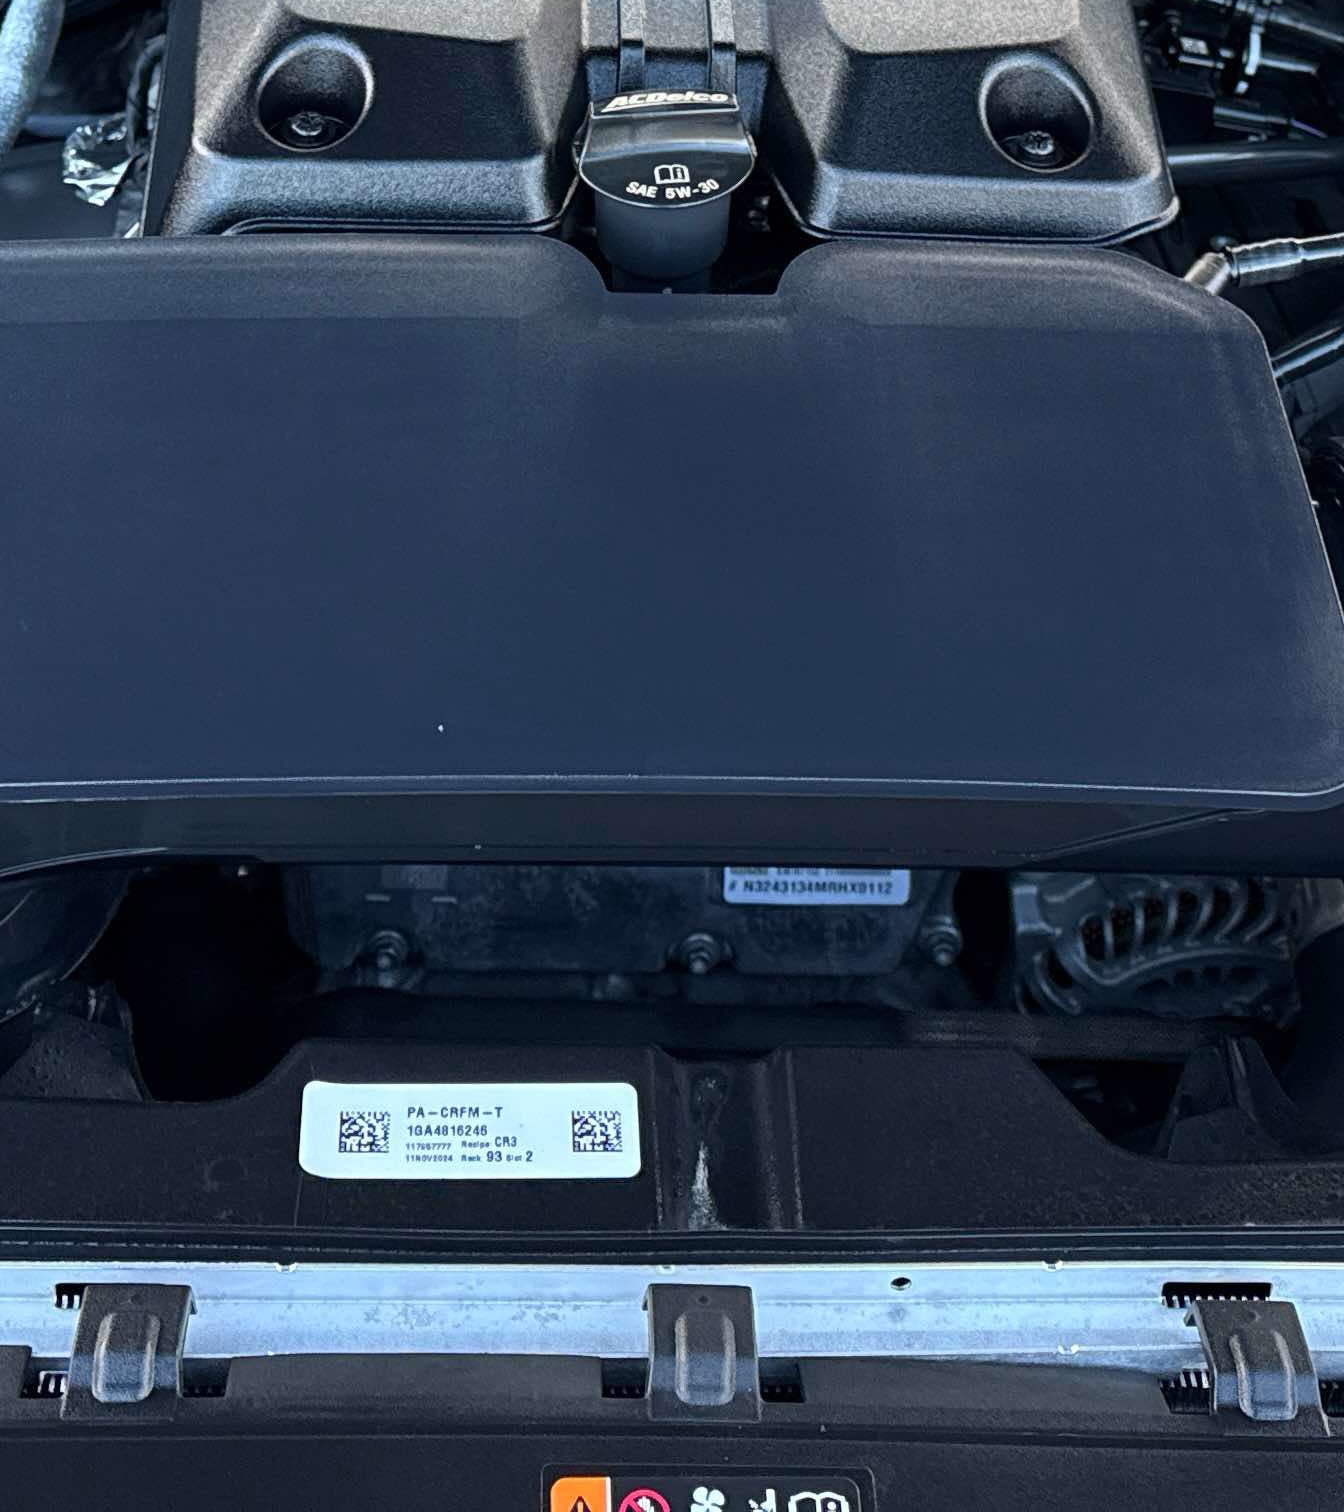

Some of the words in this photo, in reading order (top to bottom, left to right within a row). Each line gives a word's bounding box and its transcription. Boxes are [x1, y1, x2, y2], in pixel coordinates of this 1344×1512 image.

[606, 91, 729, 109] ACDelco
[625, 181, 659, 199] SAE
[665, 179, 720, 199] 5W-30
[494, 1136, 518, 1148] CR3
[486, 1151, 503, 1162] 93
[525, 1151, 534, 1162] 2
